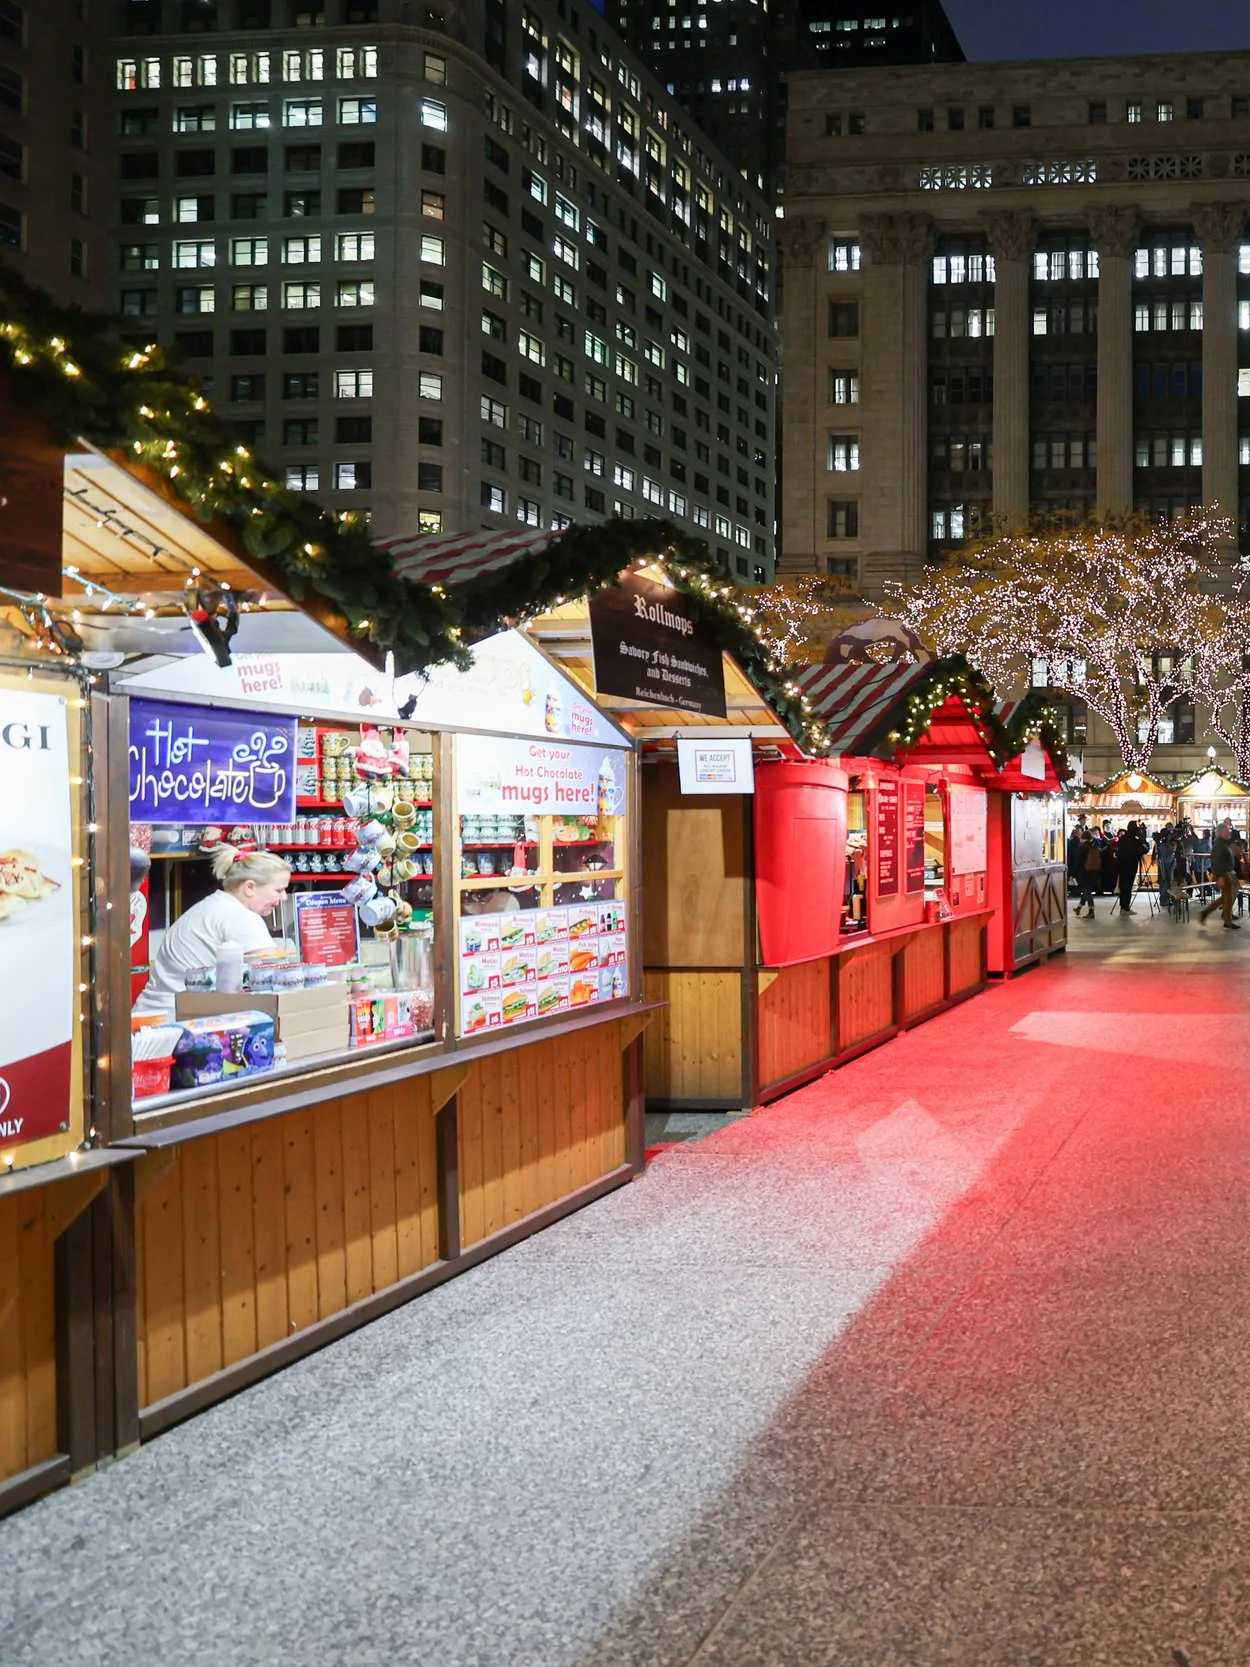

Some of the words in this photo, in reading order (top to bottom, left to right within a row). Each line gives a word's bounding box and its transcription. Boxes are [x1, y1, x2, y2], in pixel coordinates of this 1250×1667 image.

[633, 594, 694, 636] Rollmops
[619, 641, 650, 663] Savory
[652, 650, 670, 668] Fish
[236, 661, 282, 677] mugs
[647, 667, 660, 679] and
[661, 667, 692, 687] Desserts
[241, 674, 283, 694] here!
[571, 711, 593, 726] mugs
[571, 722, 592, 736] here!
[145, 718, 210, 768] Hot
[529, 744, 547, 760] Get
[548, 750, 571, 762] your
[129, 744, 250, 808] Chocolate
[515, 765, 534, 778] Hot
[536, 766, 584, 780] Chocolate
[502, 783, 549, 805] mugs
[555, 782, 595, 803] here!
